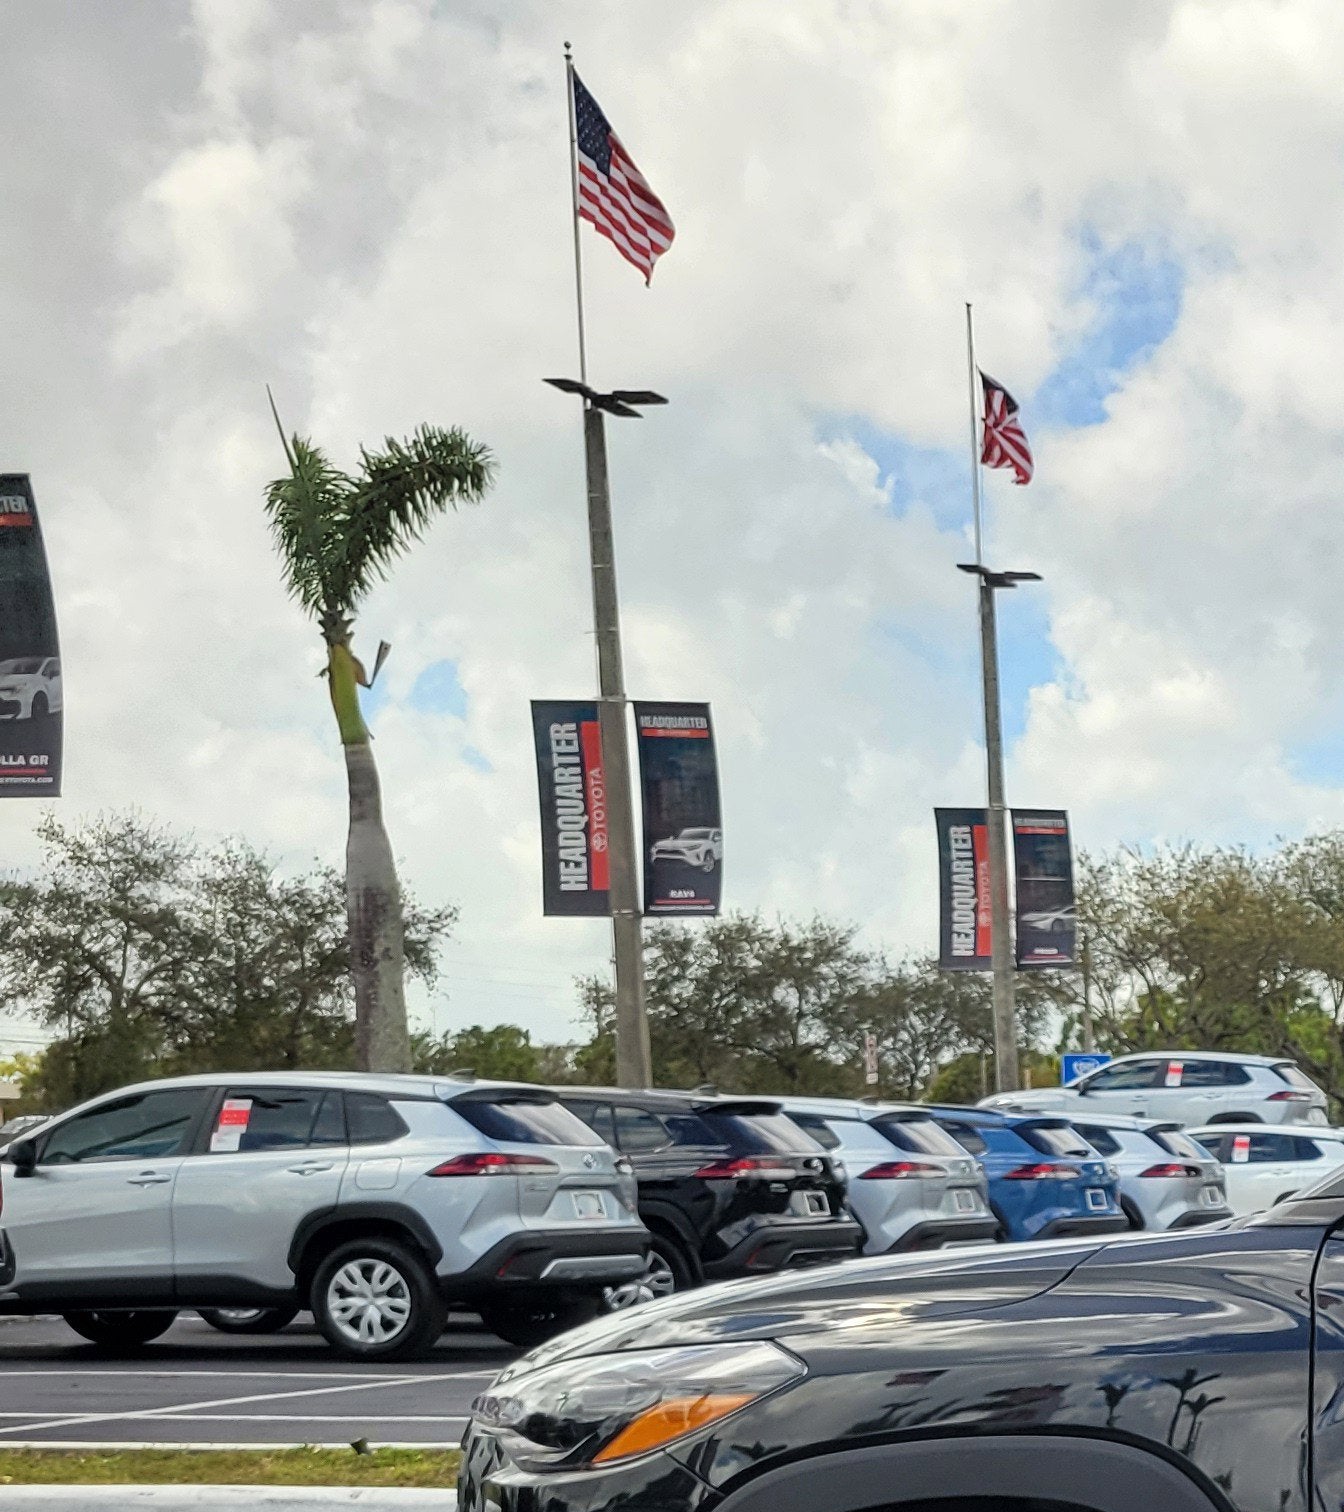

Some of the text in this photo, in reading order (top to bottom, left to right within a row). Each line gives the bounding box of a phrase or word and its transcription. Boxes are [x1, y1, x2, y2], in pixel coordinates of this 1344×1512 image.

[0, 754, 49, 765] LLA GR
[549, 722, 589, 891] HEADQUARTER
[590, 768, 605, 830] TOYOTA
[949, 825, 979, 957] HEADQUARTER
